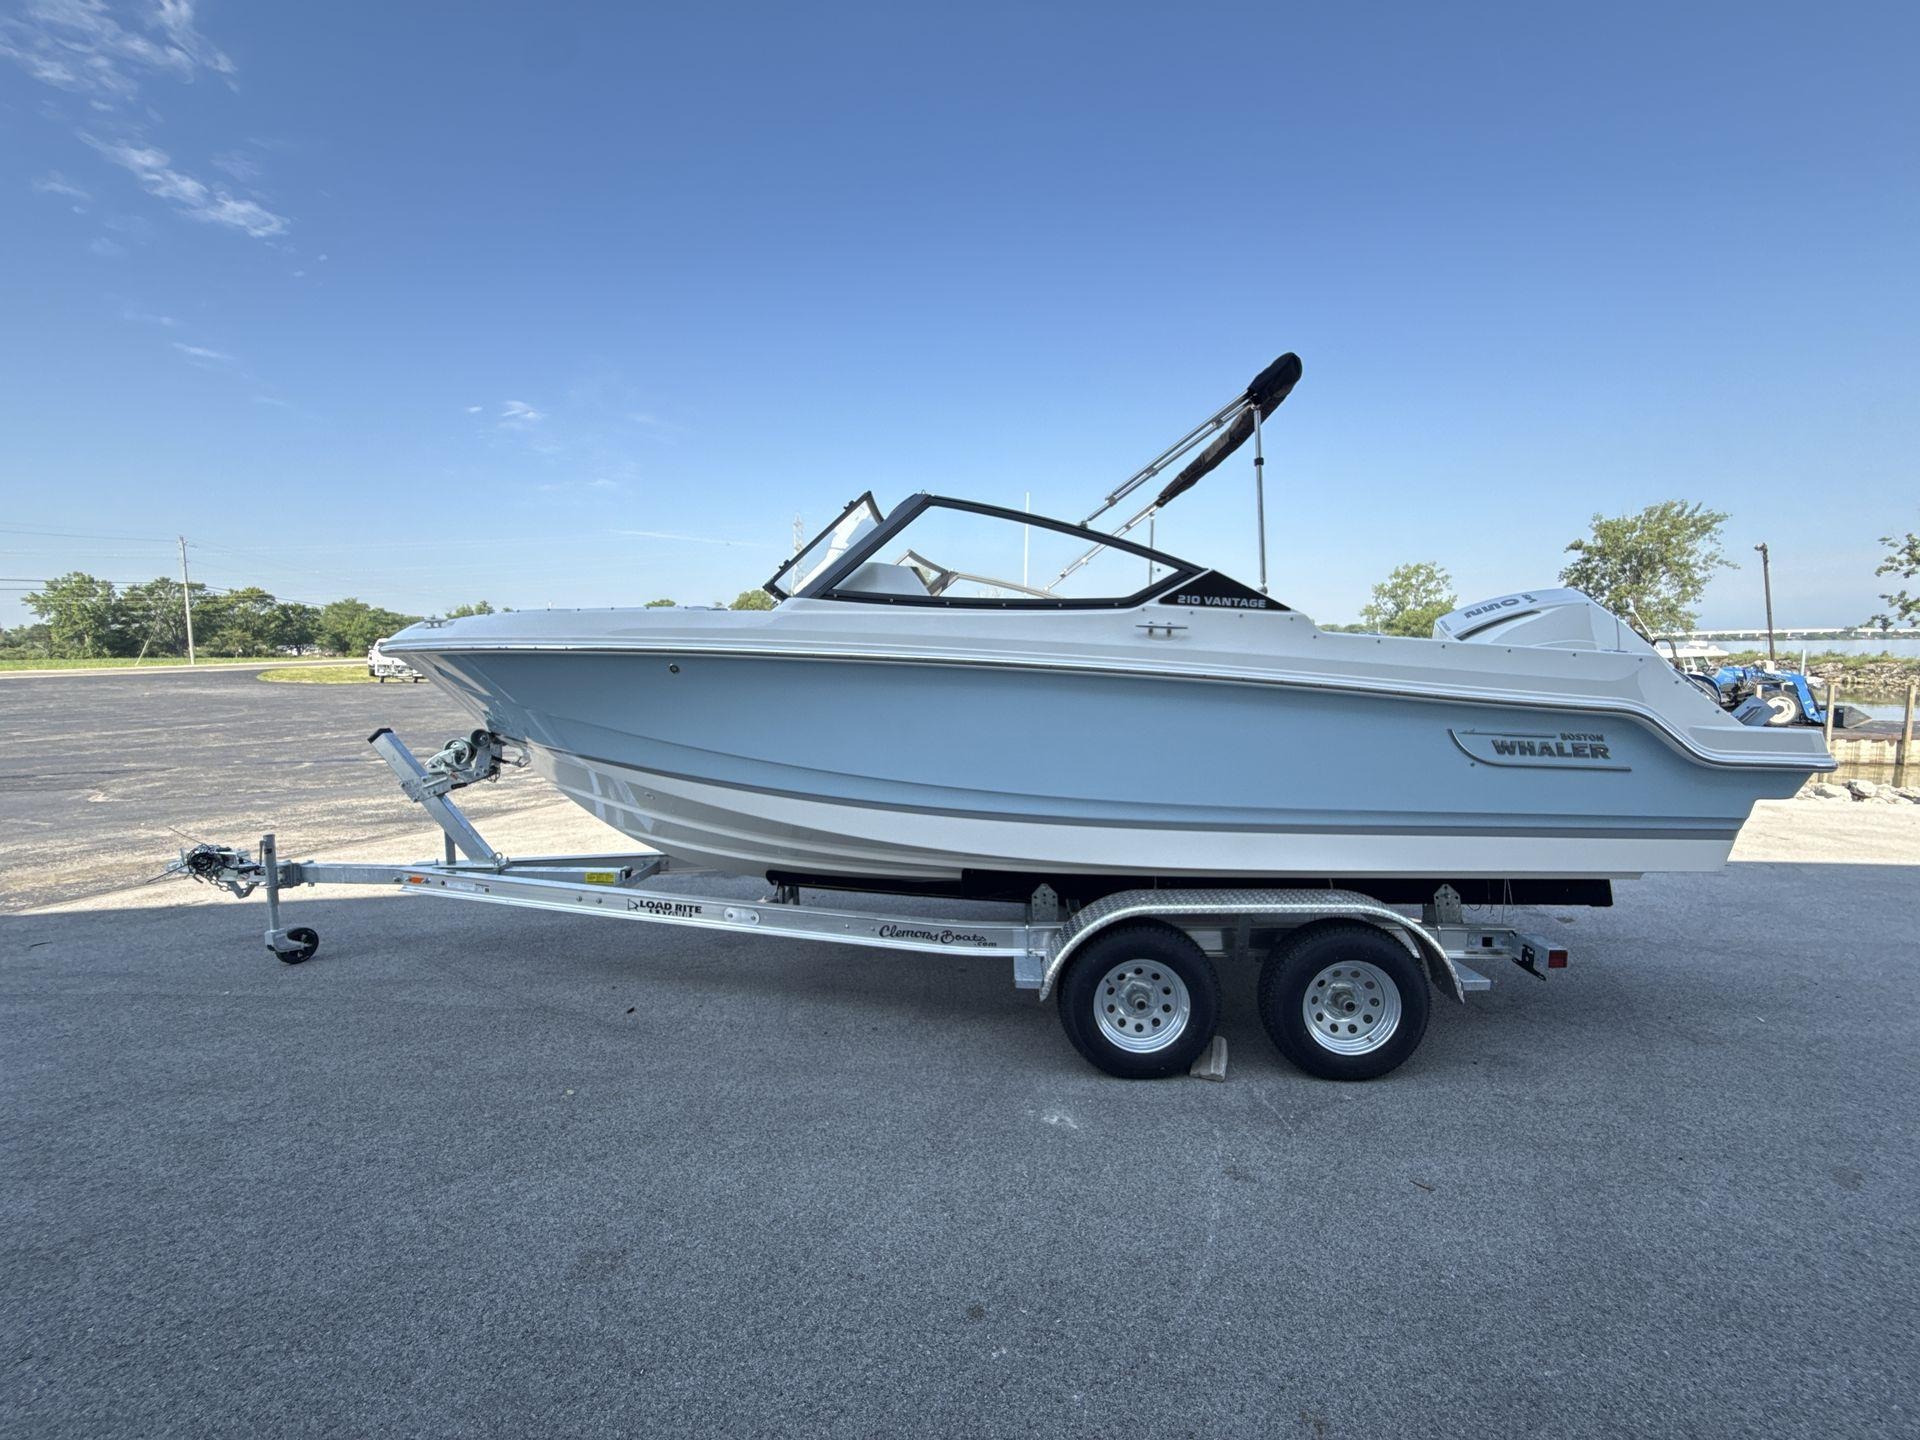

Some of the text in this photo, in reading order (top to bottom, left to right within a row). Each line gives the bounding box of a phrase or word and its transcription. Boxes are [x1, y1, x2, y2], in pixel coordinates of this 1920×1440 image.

[1177, 594, 1267, 609] 210 VANTAGE
[1560, 732, 1605, 742] BOSTON
[1491, 739, 1611, 760] WHALER
[640, 900, 672, 911] LOAD
[675, 904, 702, 914] RITE
[879, 924, 987, 944] Clemons Boats
